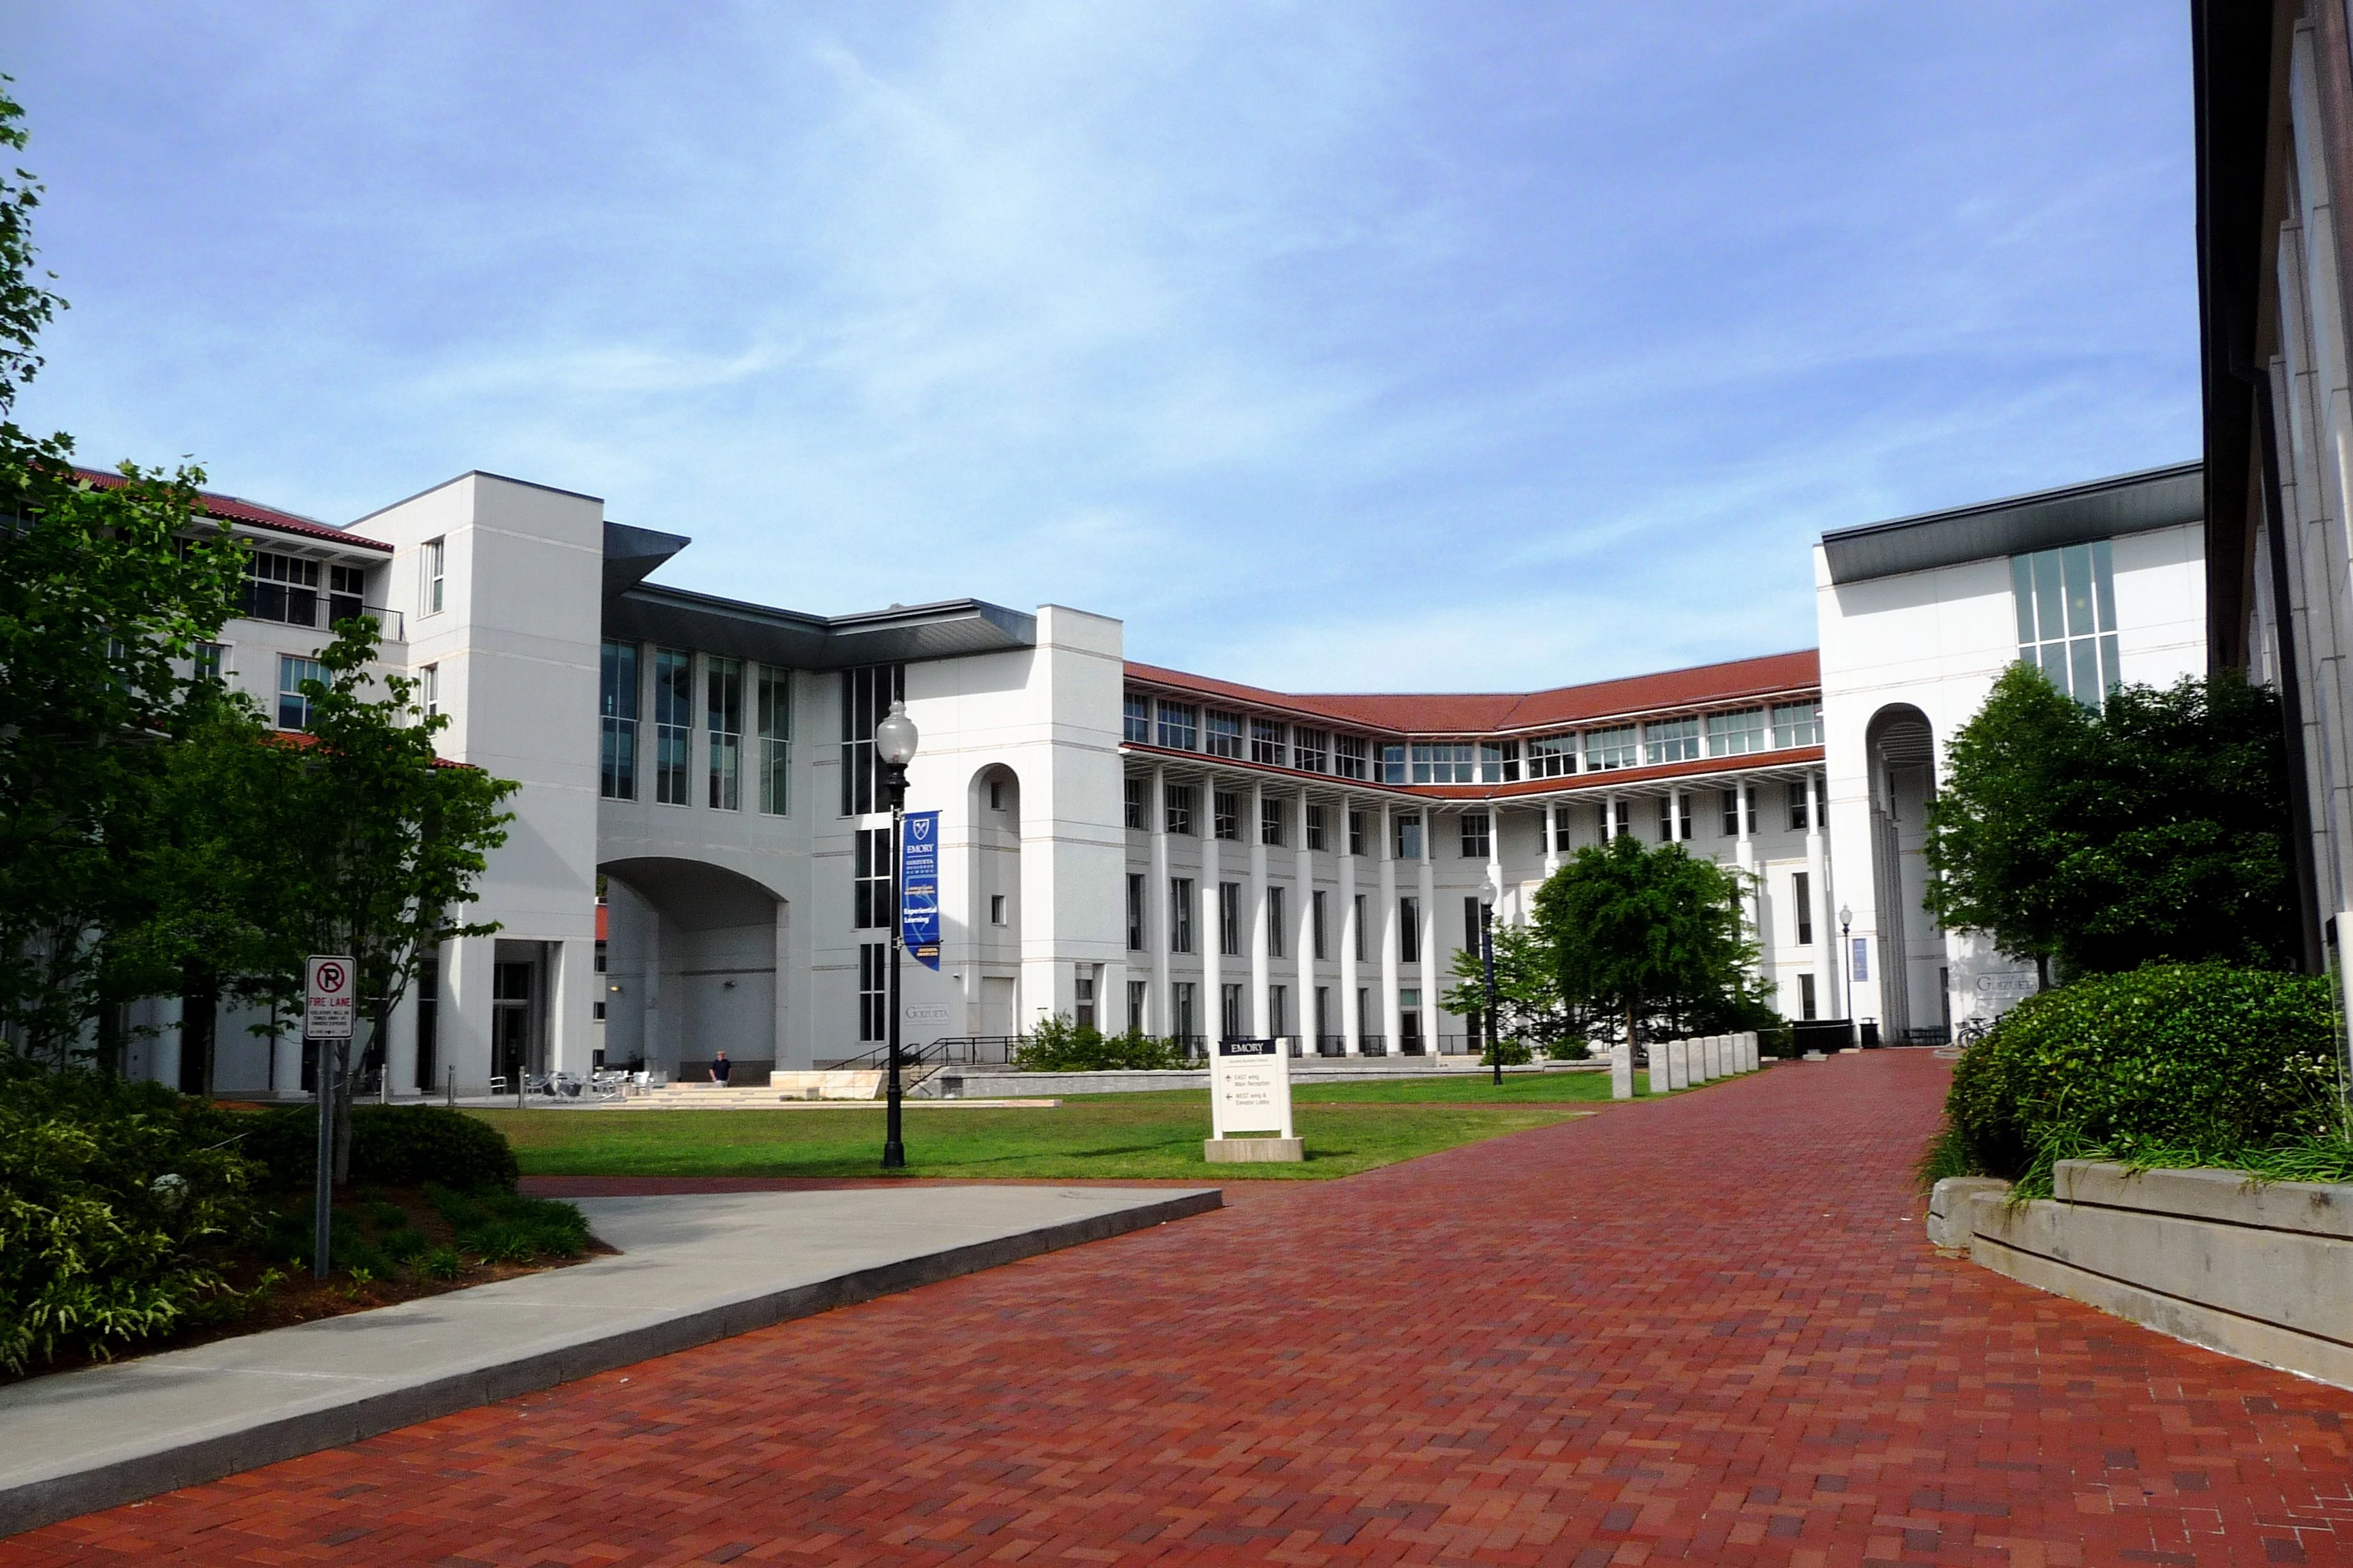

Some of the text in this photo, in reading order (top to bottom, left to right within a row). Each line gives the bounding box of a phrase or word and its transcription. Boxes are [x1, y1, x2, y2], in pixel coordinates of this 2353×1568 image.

[907, 843, 934, 853] EMORY
[903, 906, 938, 915] Experiential
[903, 915, 929, 924] Learning
[309, 997, 351, 1007] FIRE LANE
[1231, 1043, 1264, 1053] EMORY
